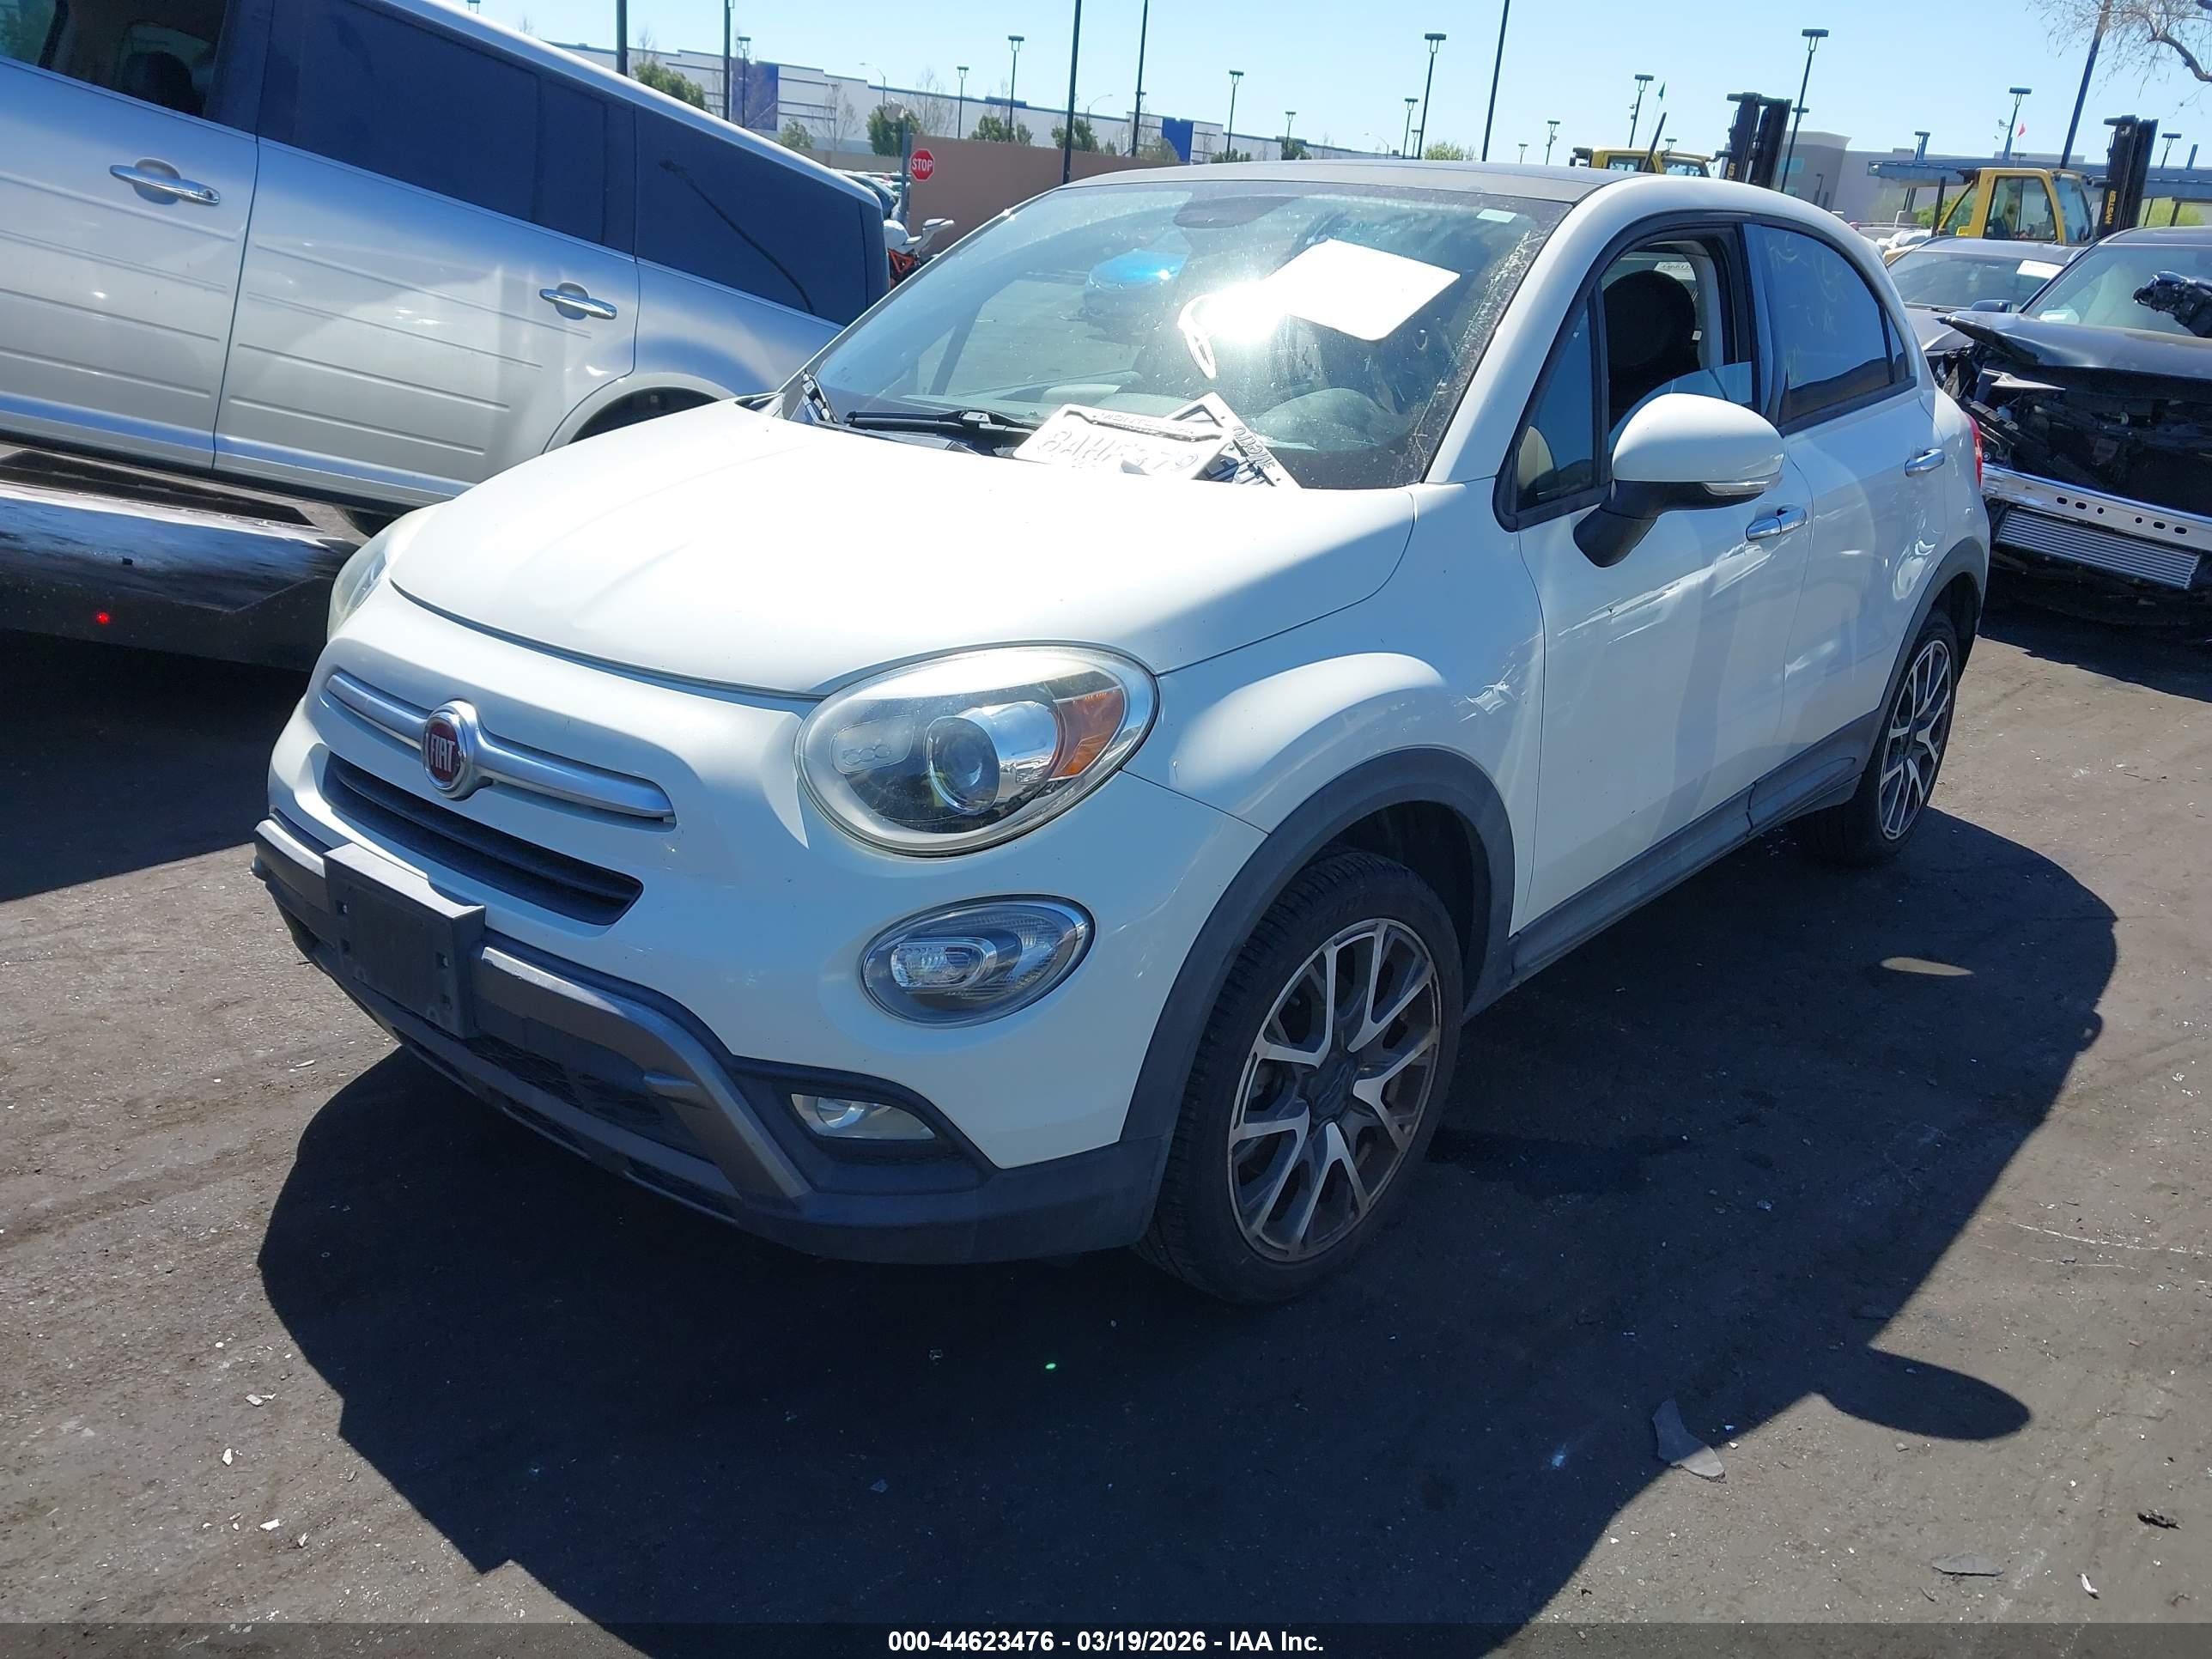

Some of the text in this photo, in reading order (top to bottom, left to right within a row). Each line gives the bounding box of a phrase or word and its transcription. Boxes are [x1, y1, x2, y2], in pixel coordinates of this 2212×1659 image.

[912, 157, 933, 173] STOP
[2105, 190, 2117, 224] HYSTER
[430, 733, 456, 773] FIAT
